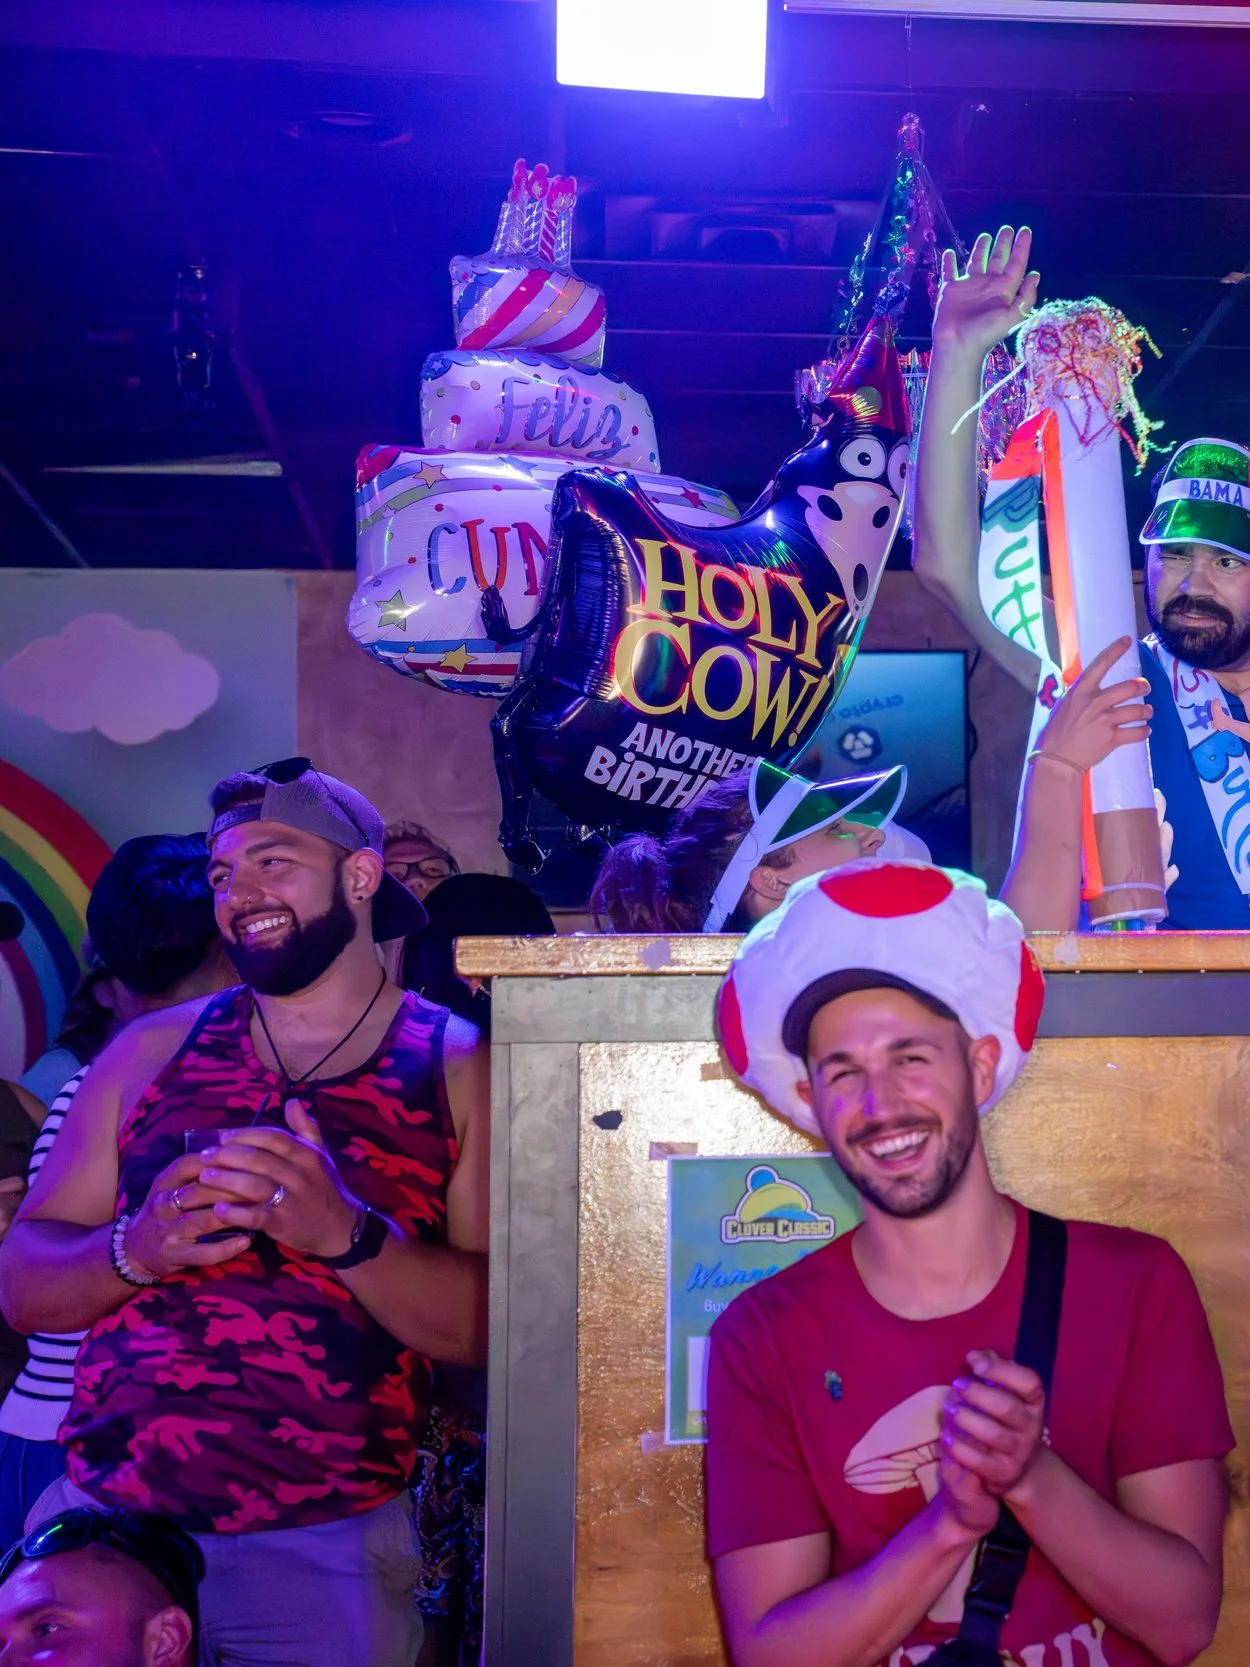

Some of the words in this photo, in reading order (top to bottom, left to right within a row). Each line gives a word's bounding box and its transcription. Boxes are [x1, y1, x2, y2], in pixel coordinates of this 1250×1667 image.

[495, 375, 631, 460] Feliz
[1188, 479, 1244, 508] BAMA
[626, 538, 846, 669] HOLY
[613, 618, 831, 749] COW!
